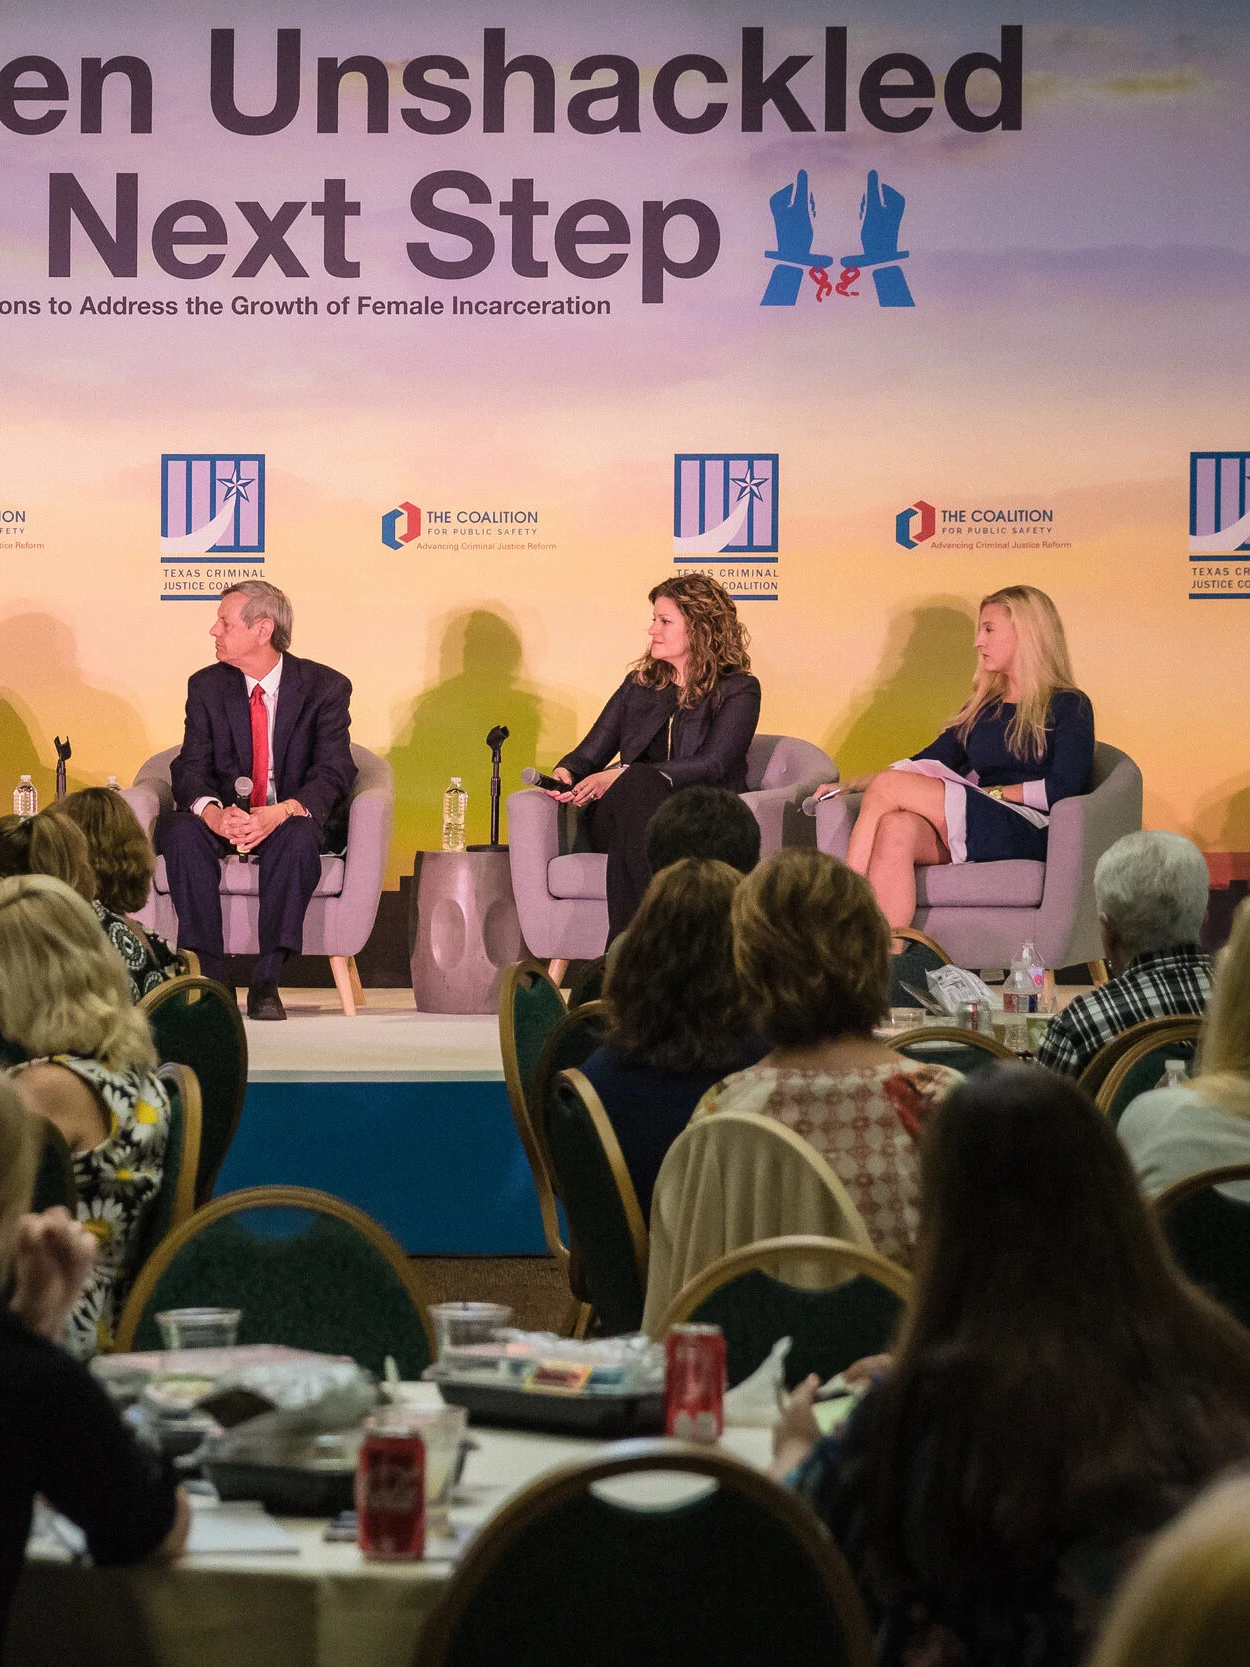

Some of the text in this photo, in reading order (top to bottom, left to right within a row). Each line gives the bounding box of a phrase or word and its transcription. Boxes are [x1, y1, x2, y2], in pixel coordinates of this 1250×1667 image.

[210, 25, 1025, 135] Unshackled
[47, 170, 361, 279] Next
[406, 170, 721, 304] Step
[48, 297, 72, 315] to
[80, 296, 177, 315] Address
[186, 296, 223, 315] the
[232, 296, 317, 315] Growth
[327, 296, 349, 315] of
[358, 296, 444, 315] Female
[453, 296, 610, 315] Incarceration
[427, 511, 538, 523] THE COALITION
[941, 510, 1054, 523] THE COALITION
[453, 528, 492, 536] PUBLIC
[497, 528, 538, 536] SAFETY
[942, 527, 1052, 535] FOR PUBLIC SAFETY
[15, 541, 45, 550] Reform
[416, 542, 557, 552] Advancing Criminal Justice Reform
[930, 541, 1072, 551] Advancing Criminal Justice Reform
[163, 569, 266, 578] TEXAS CRIMINAL
[719, 568, 779, 578] CRIMINAL
[1192, 567, 1230, 576] TEXAS
[163, 581, 204, 590] JUSTICE
[722, 581, 778, 590] COALITION
[1192, 580, 1234, 589] JUSTICE
